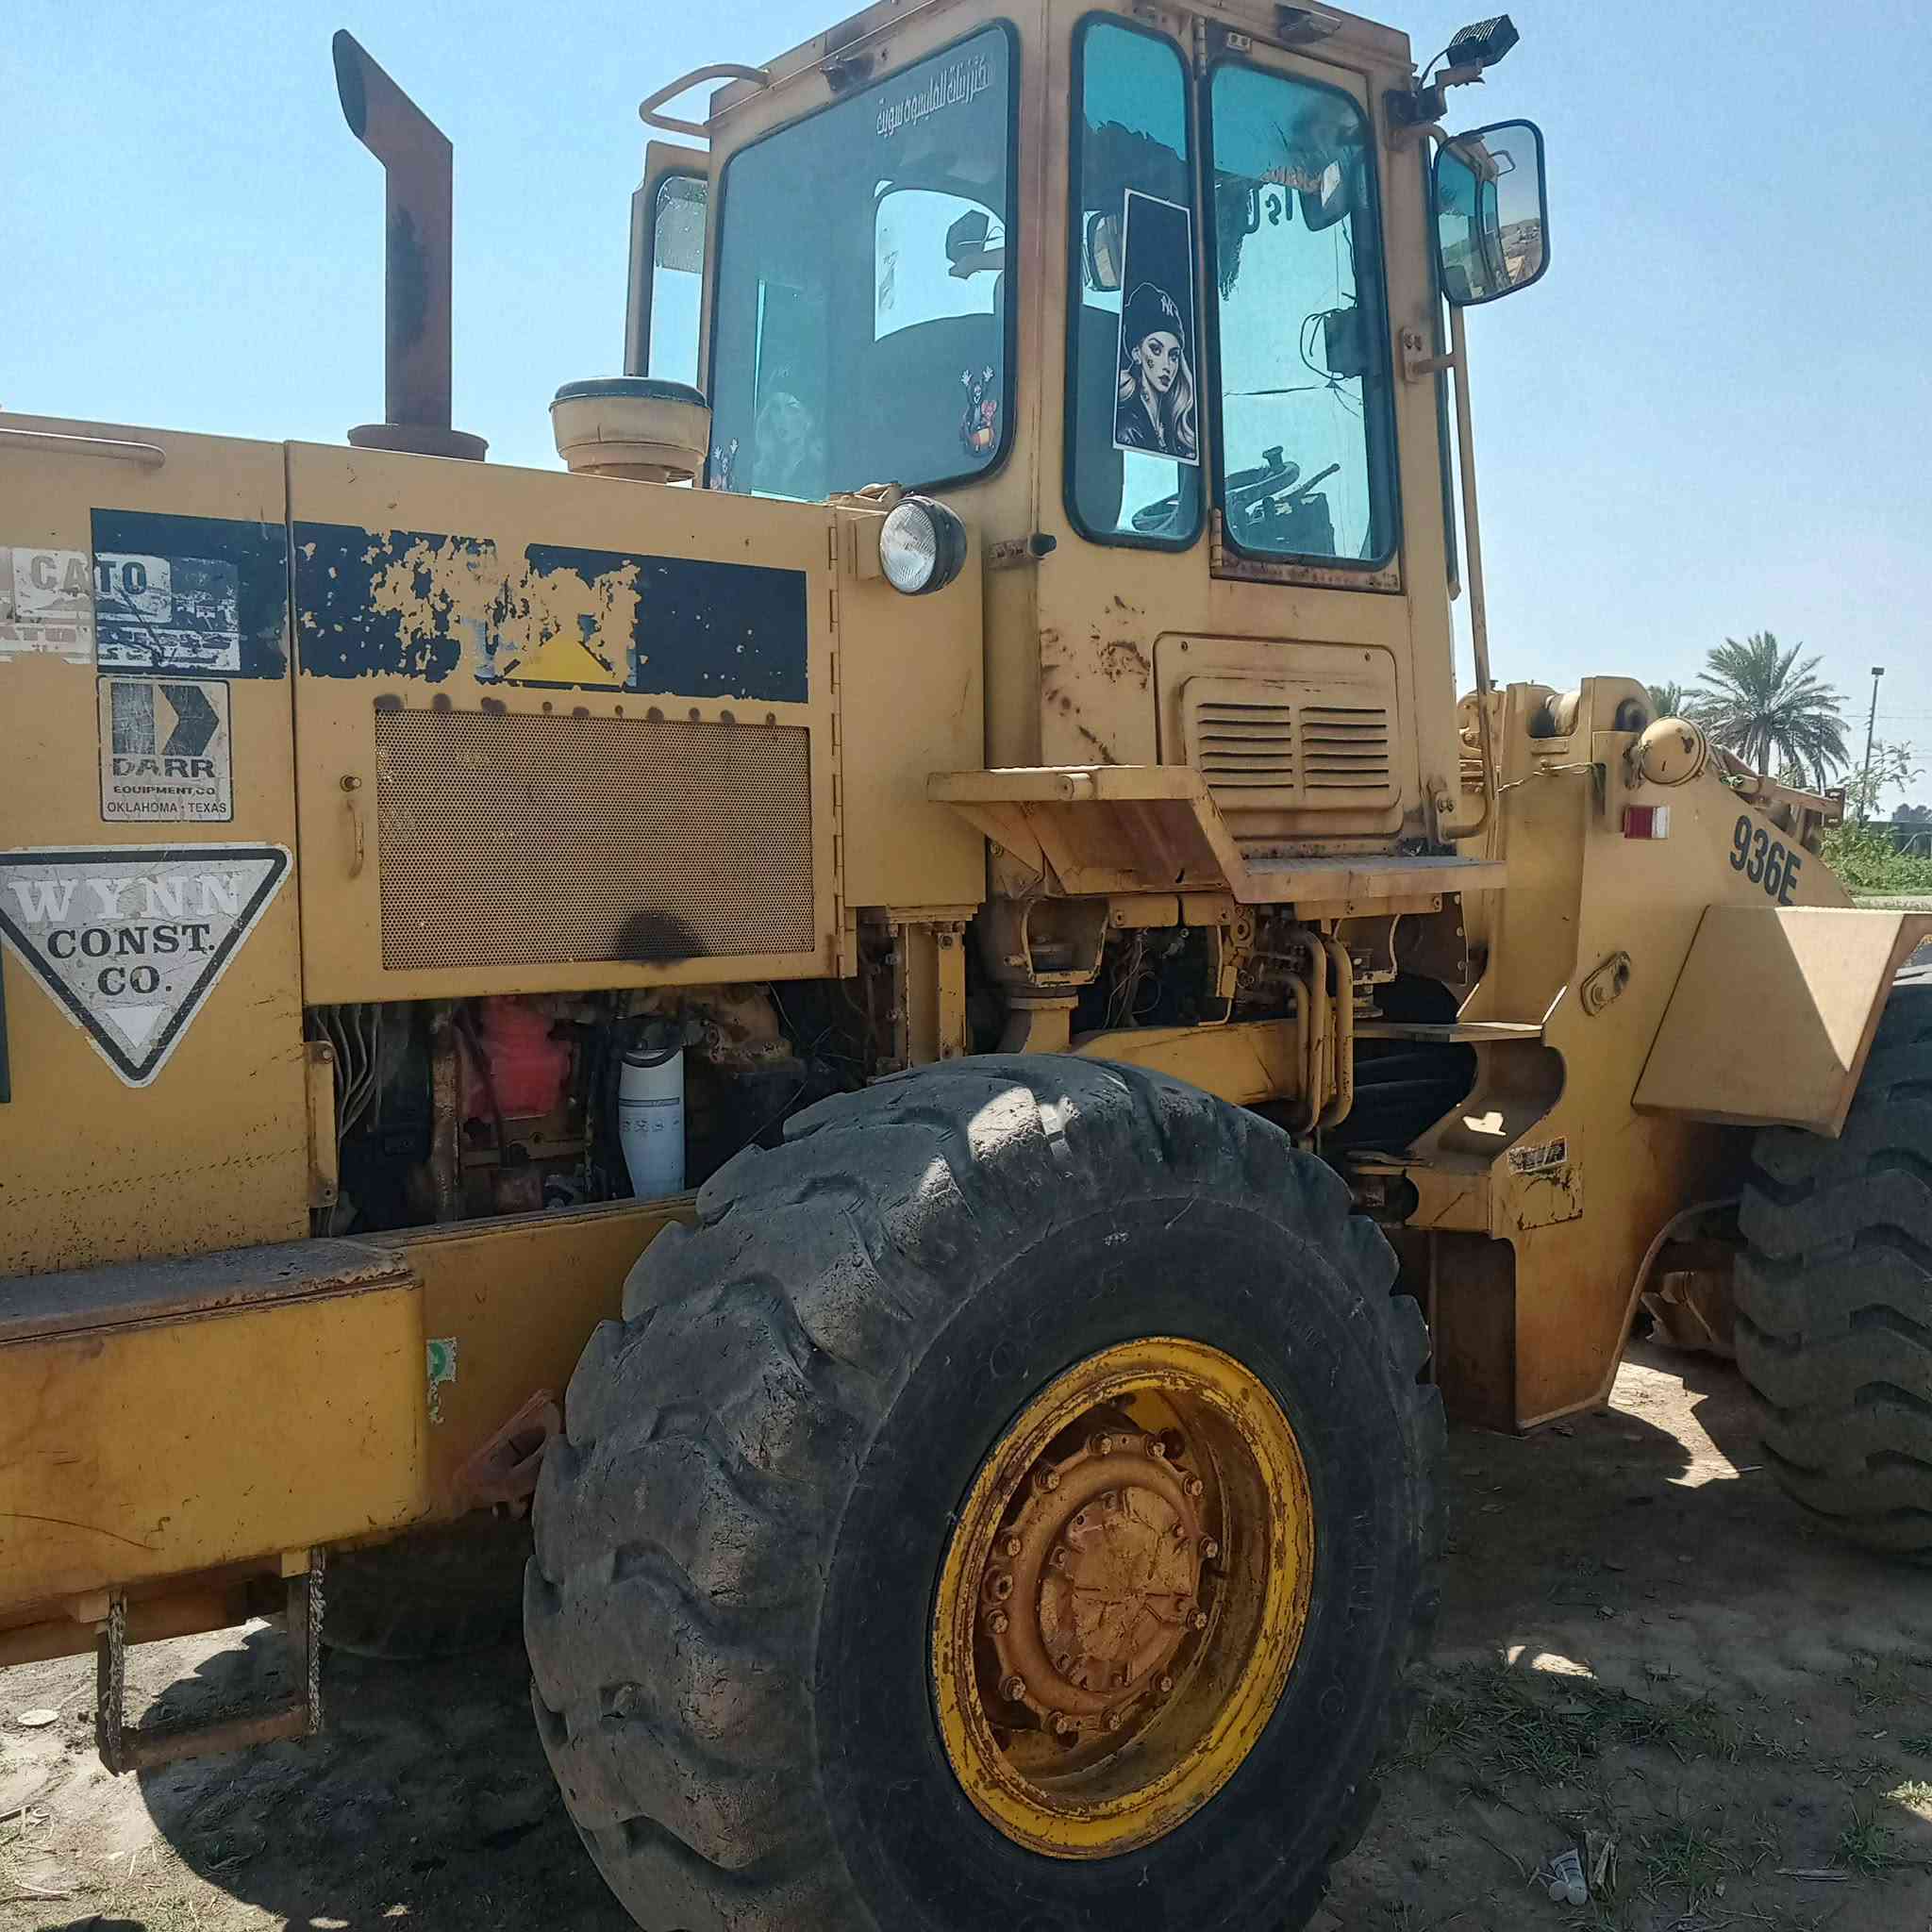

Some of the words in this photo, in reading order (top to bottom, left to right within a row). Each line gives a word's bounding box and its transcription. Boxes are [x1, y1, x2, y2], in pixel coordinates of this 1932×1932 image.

[112, 758, 216, 778] DARR
[106, 802, 178, 814] OKLAHOMA
[188, 802, 227, 814] TEXAS
[1729, 814, 1803, 907] 936E
[8, 874, 242, 923] WYNN
[47, 924, 216, 959] CONST.
[97, 964, 173, 996] CO.
